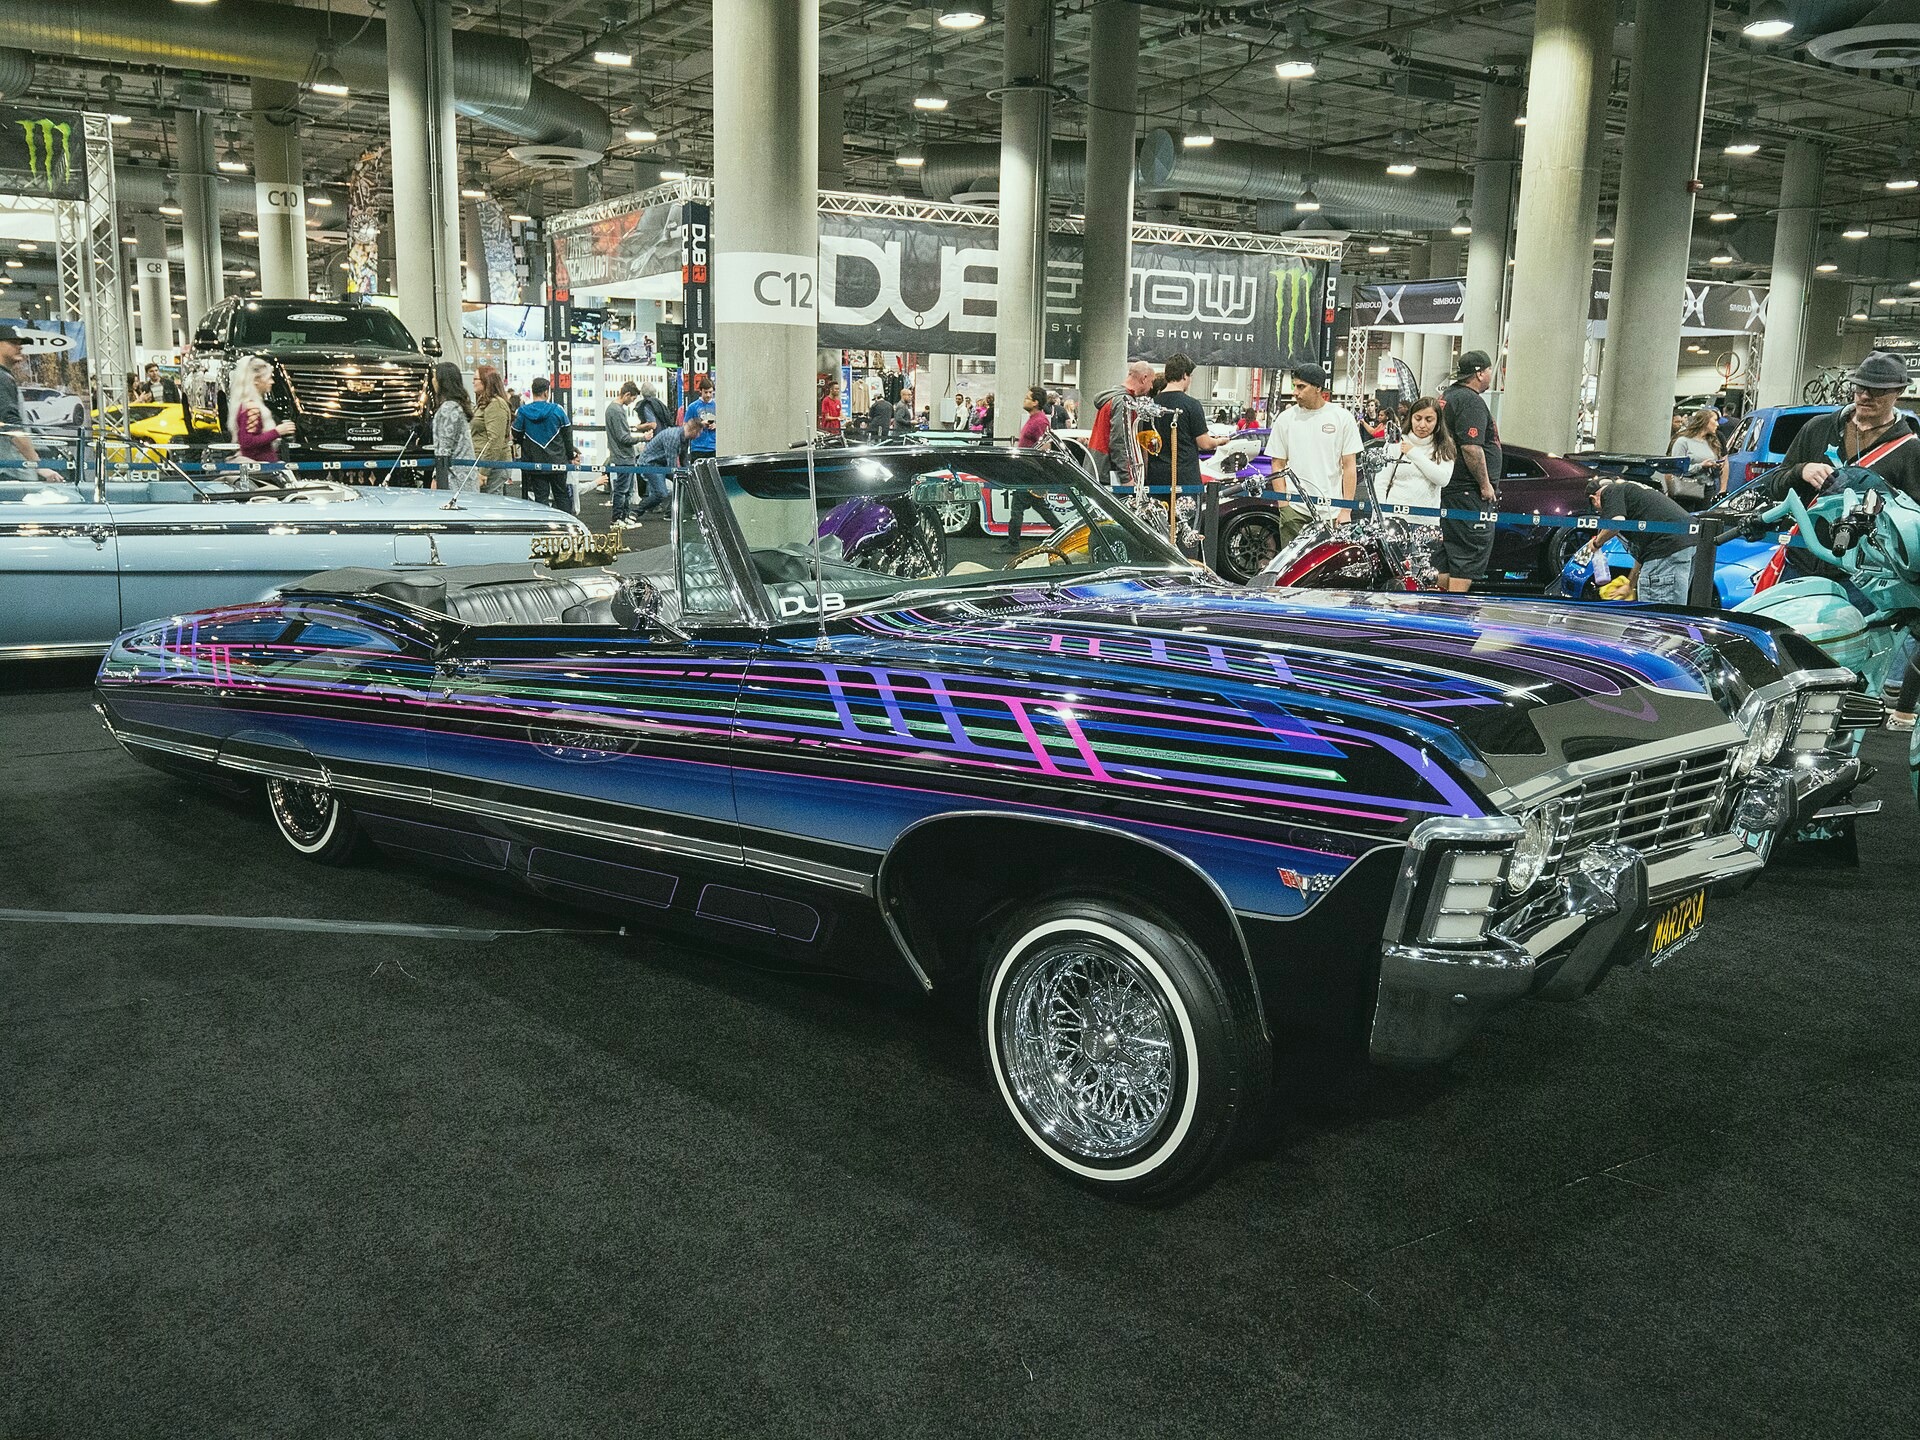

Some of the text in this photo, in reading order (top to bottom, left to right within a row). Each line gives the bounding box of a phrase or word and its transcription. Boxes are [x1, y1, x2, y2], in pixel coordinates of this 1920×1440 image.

[267, 190, 298, 208] C10
[691, 223, 707, 266] DUB
[146, 262, 162, 273] C8
[566, 256, 609, 282] TECHNOLOGY
[753, 270, 813, 309] C12
[1325, 277, 1337, 309] DUB
[1355, 301, 1382, 310] SIMBOLO
[1432, 296, 1462, 306] SIMBOLO
[1729, 303, 1752, 313] SIMBOLO
[1156, 328, 1204, 340] SHOW
[1213, 332, 1256, 343] TOUR
[558, 340, 571, 375] DUB
[693, 332, 708, 374] DUB
[323, 462, 342, 470] DUB
[401, 460, 418, 468] DUB
[1317, 497, 1331, 505] DUB
[1394, 505, 1410, 514] DUB
[1479, 511, 1498, 521] DUB
[1577, 518, 1598, 529] DUB
[779, 592, 846, 617] DUB
[1652, 887, 1705, 953] MARIPSA
